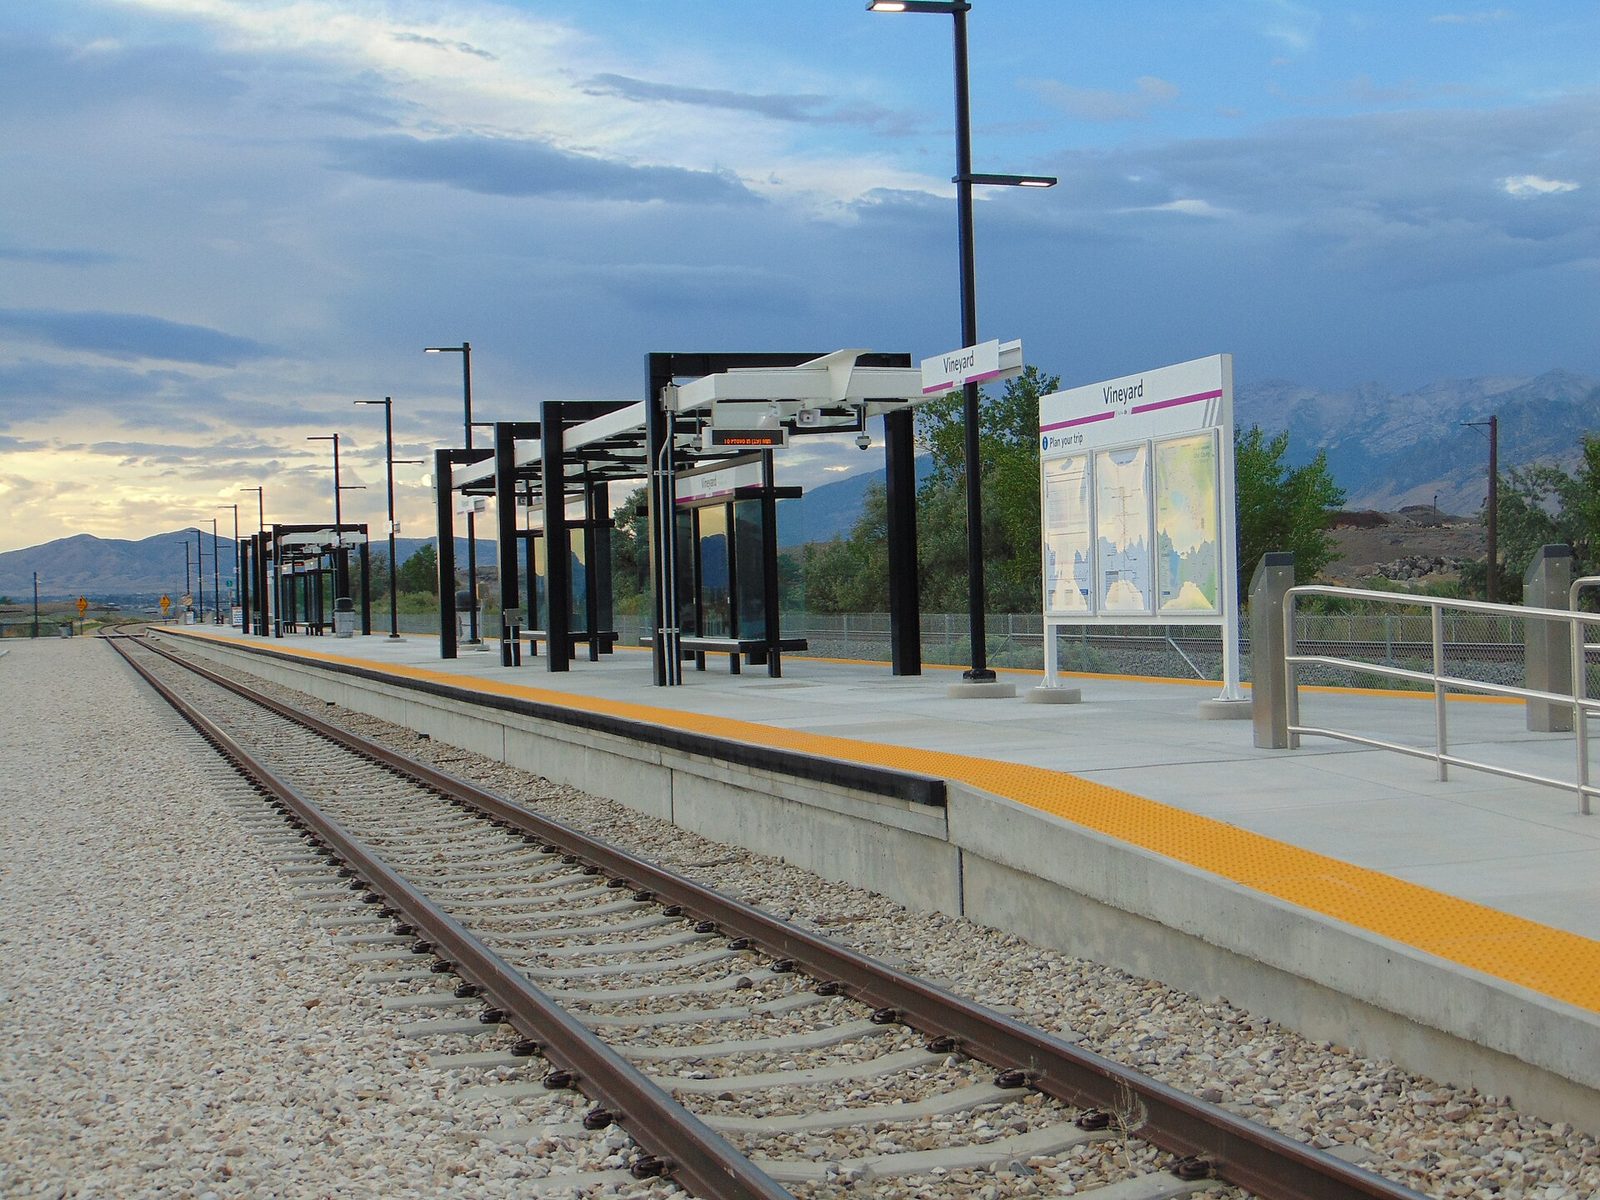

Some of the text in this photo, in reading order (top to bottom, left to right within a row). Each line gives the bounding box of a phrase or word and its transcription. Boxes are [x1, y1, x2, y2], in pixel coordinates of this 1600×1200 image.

[943, 350, 974, 373] Vineyard
[1103, 379, 1143, 405] Vineyard
[1049, 432, 1084, 448] Plan your trip
